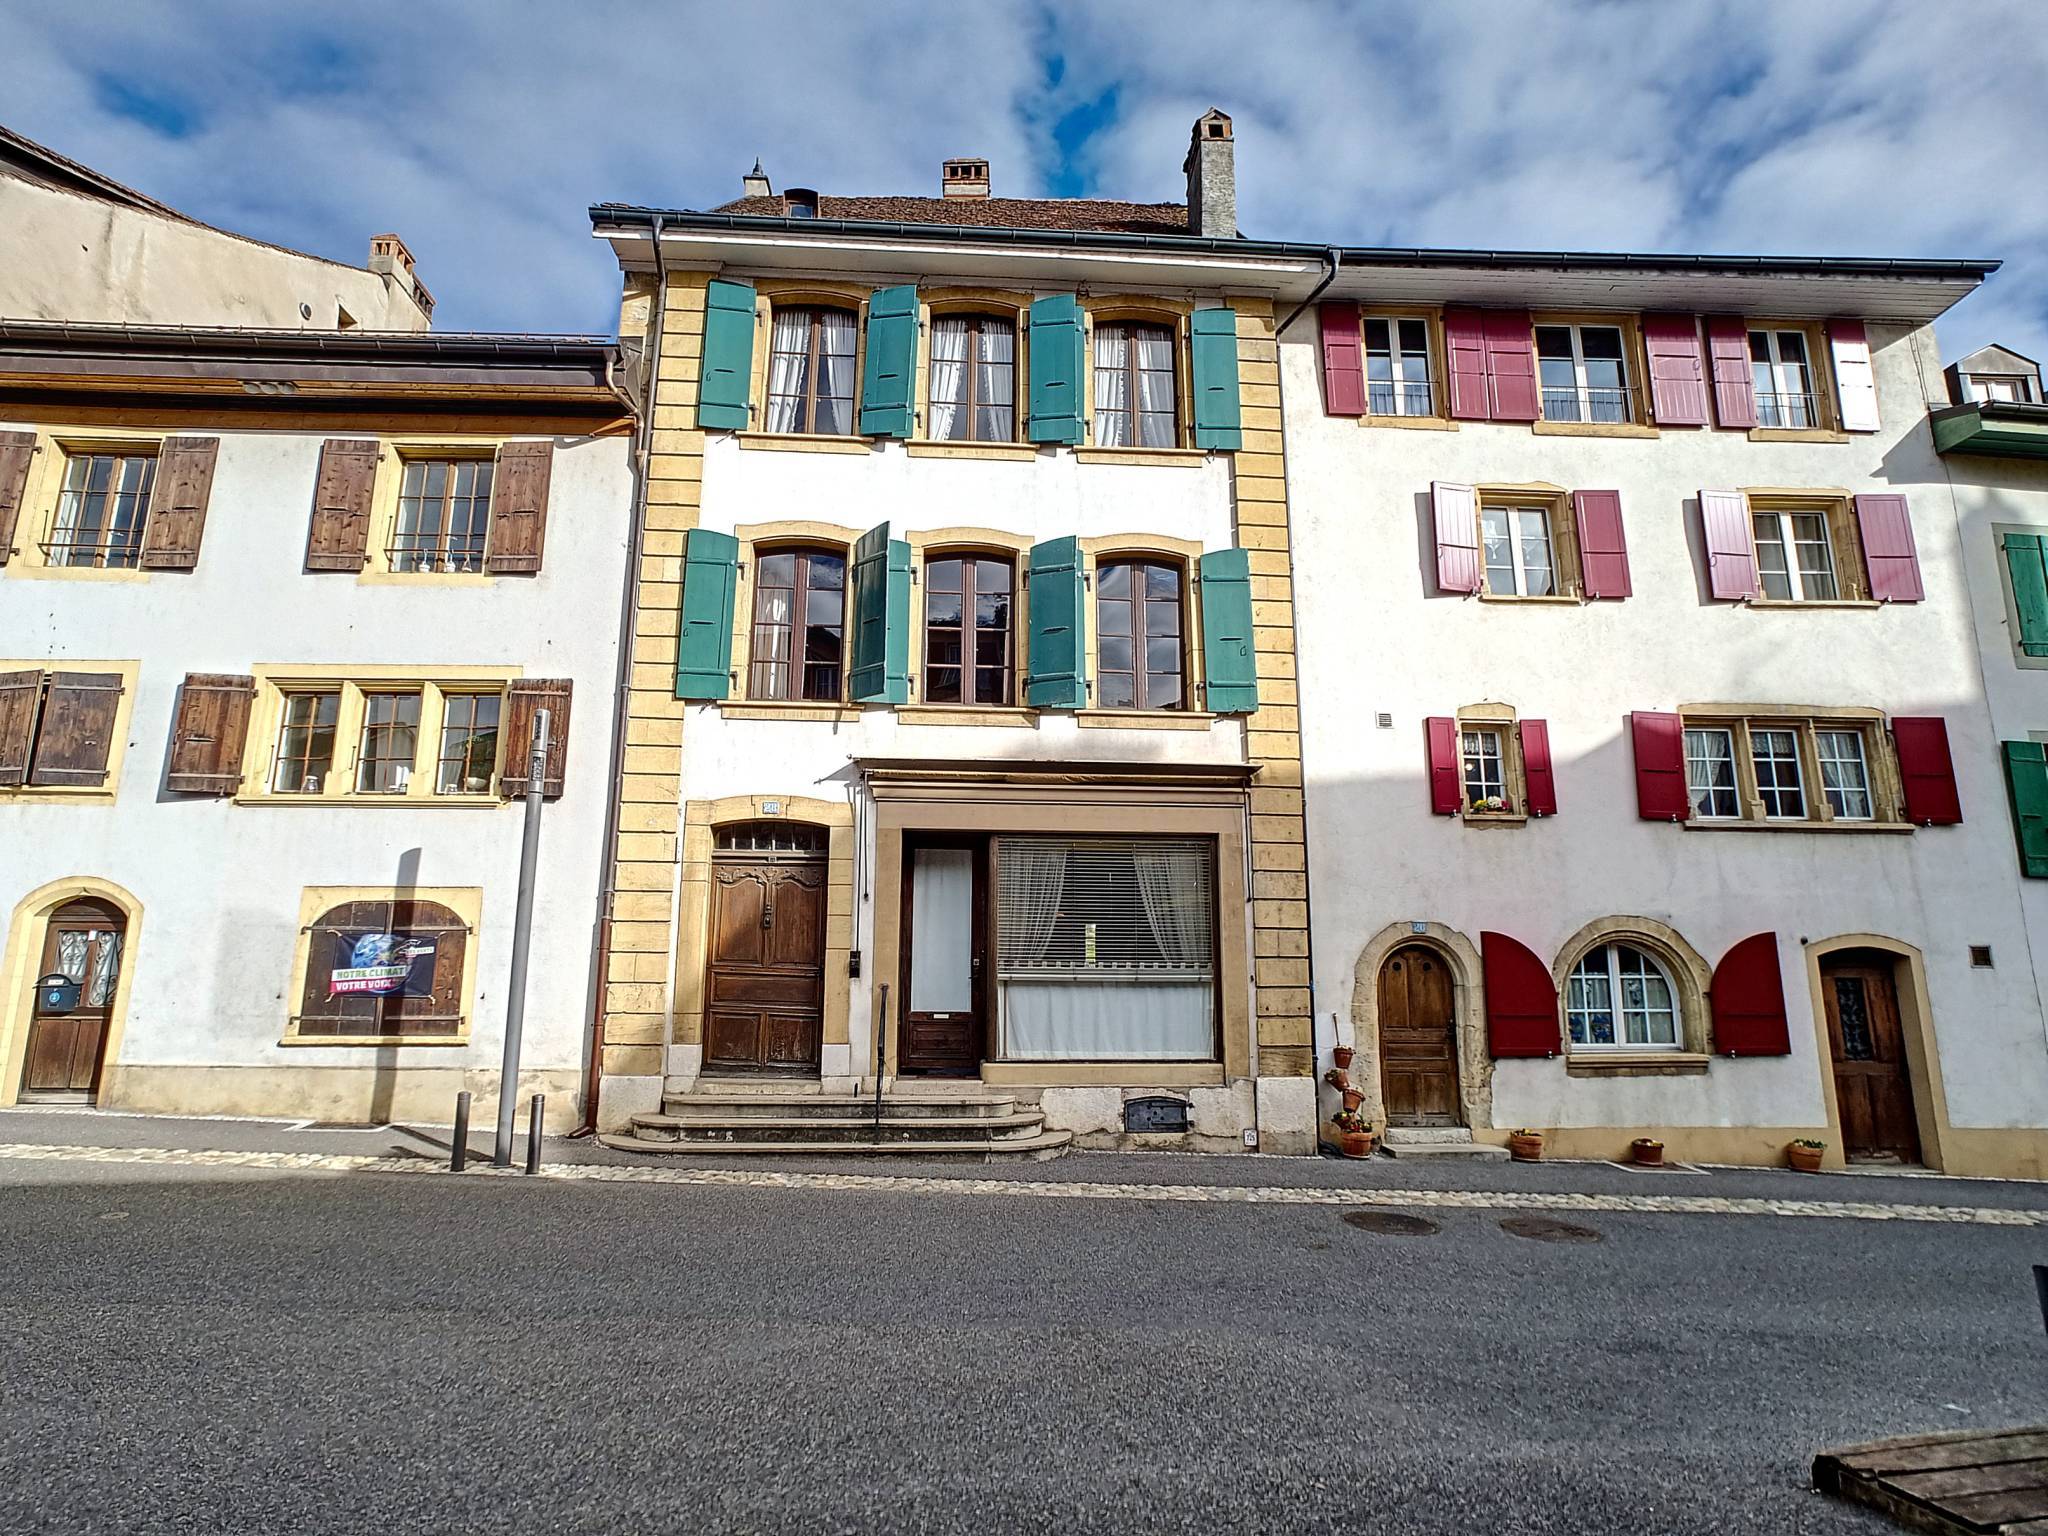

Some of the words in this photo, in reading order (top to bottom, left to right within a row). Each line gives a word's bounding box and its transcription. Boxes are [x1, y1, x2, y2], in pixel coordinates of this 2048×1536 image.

[336, 970, 367, 979] NOTRE
[369, 967, 404, 977] CLIMAT
[336, 980, 367, 990] VOTRE
